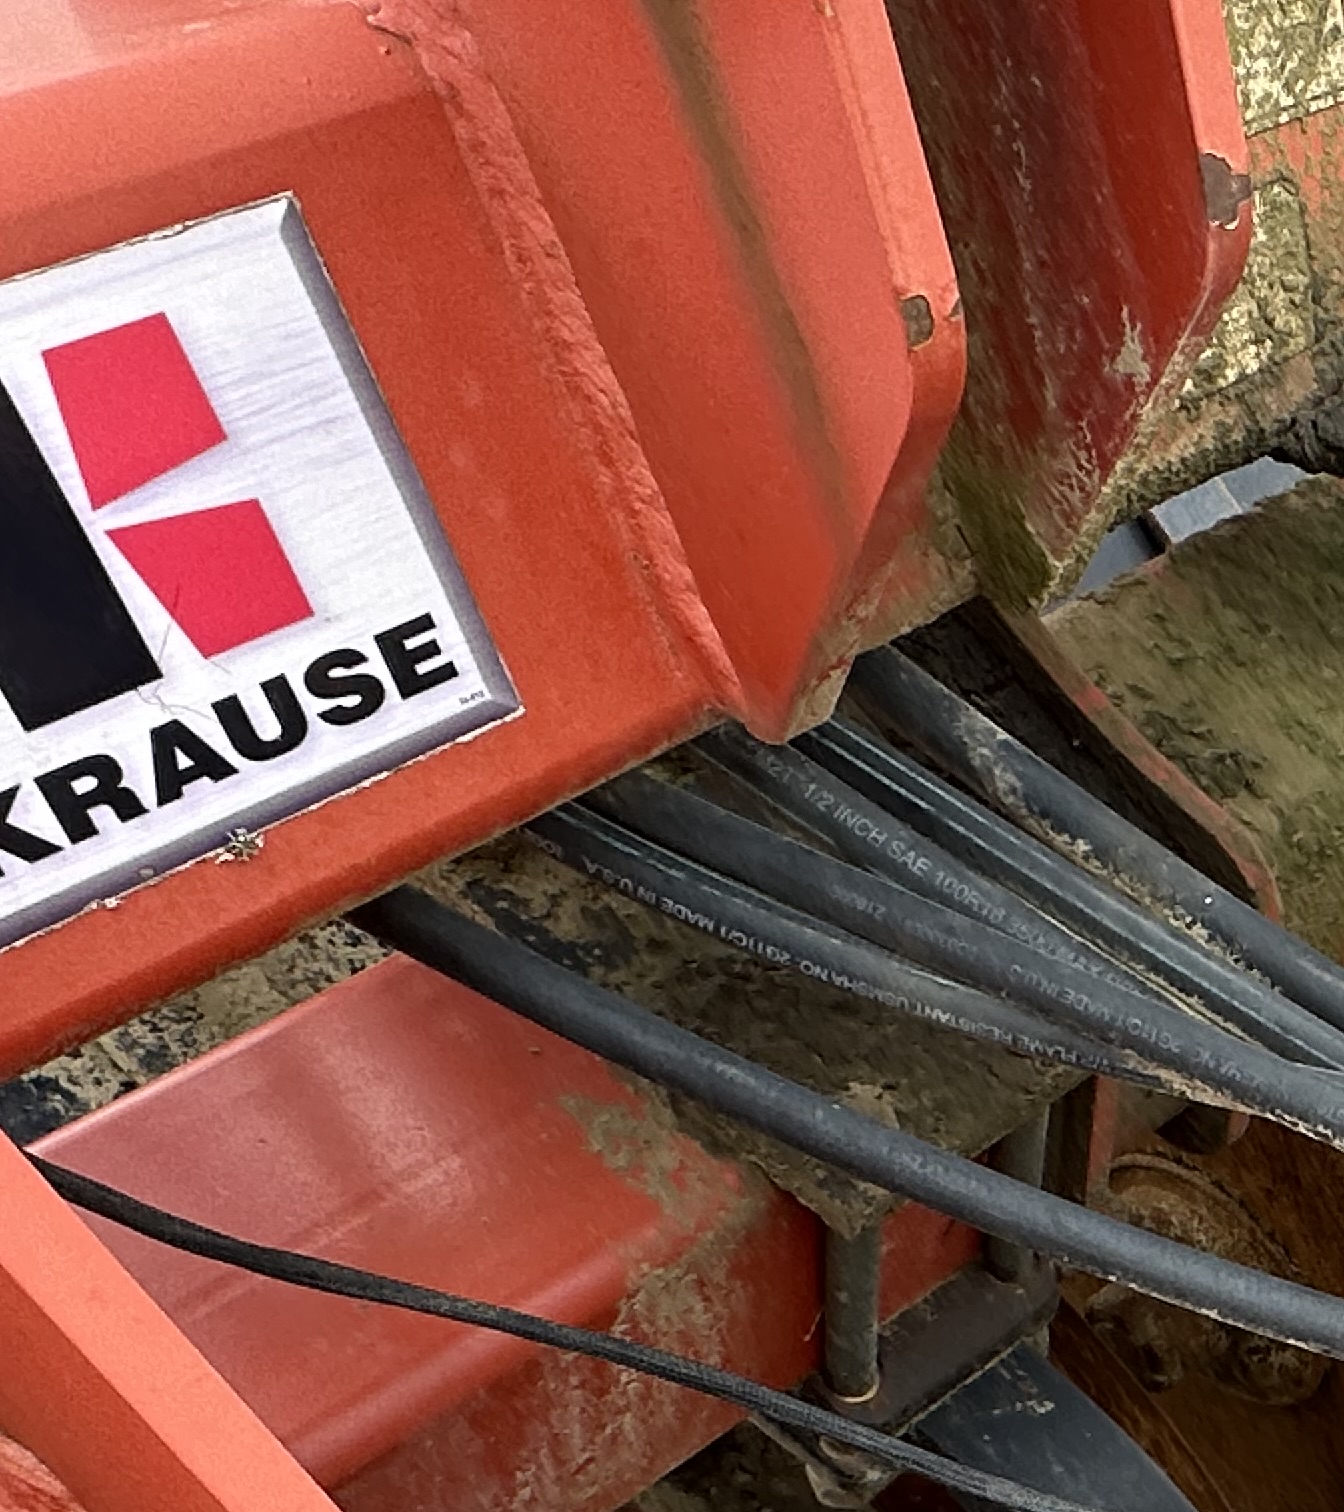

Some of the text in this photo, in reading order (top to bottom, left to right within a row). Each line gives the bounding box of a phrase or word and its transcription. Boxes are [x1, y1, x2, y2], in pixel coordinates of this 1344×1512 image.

[0, 612, 460, 878] KRAUSE
[804, 783, 834, 812] 1/2
[833, 803, 888, 847] INCH
[887, 840, 932, 877] SAE
[636, 885, 656, 905] IN
[660, 896, 715, 934] MADE
[916, 1001, 1013, 1046] RESISTANT
